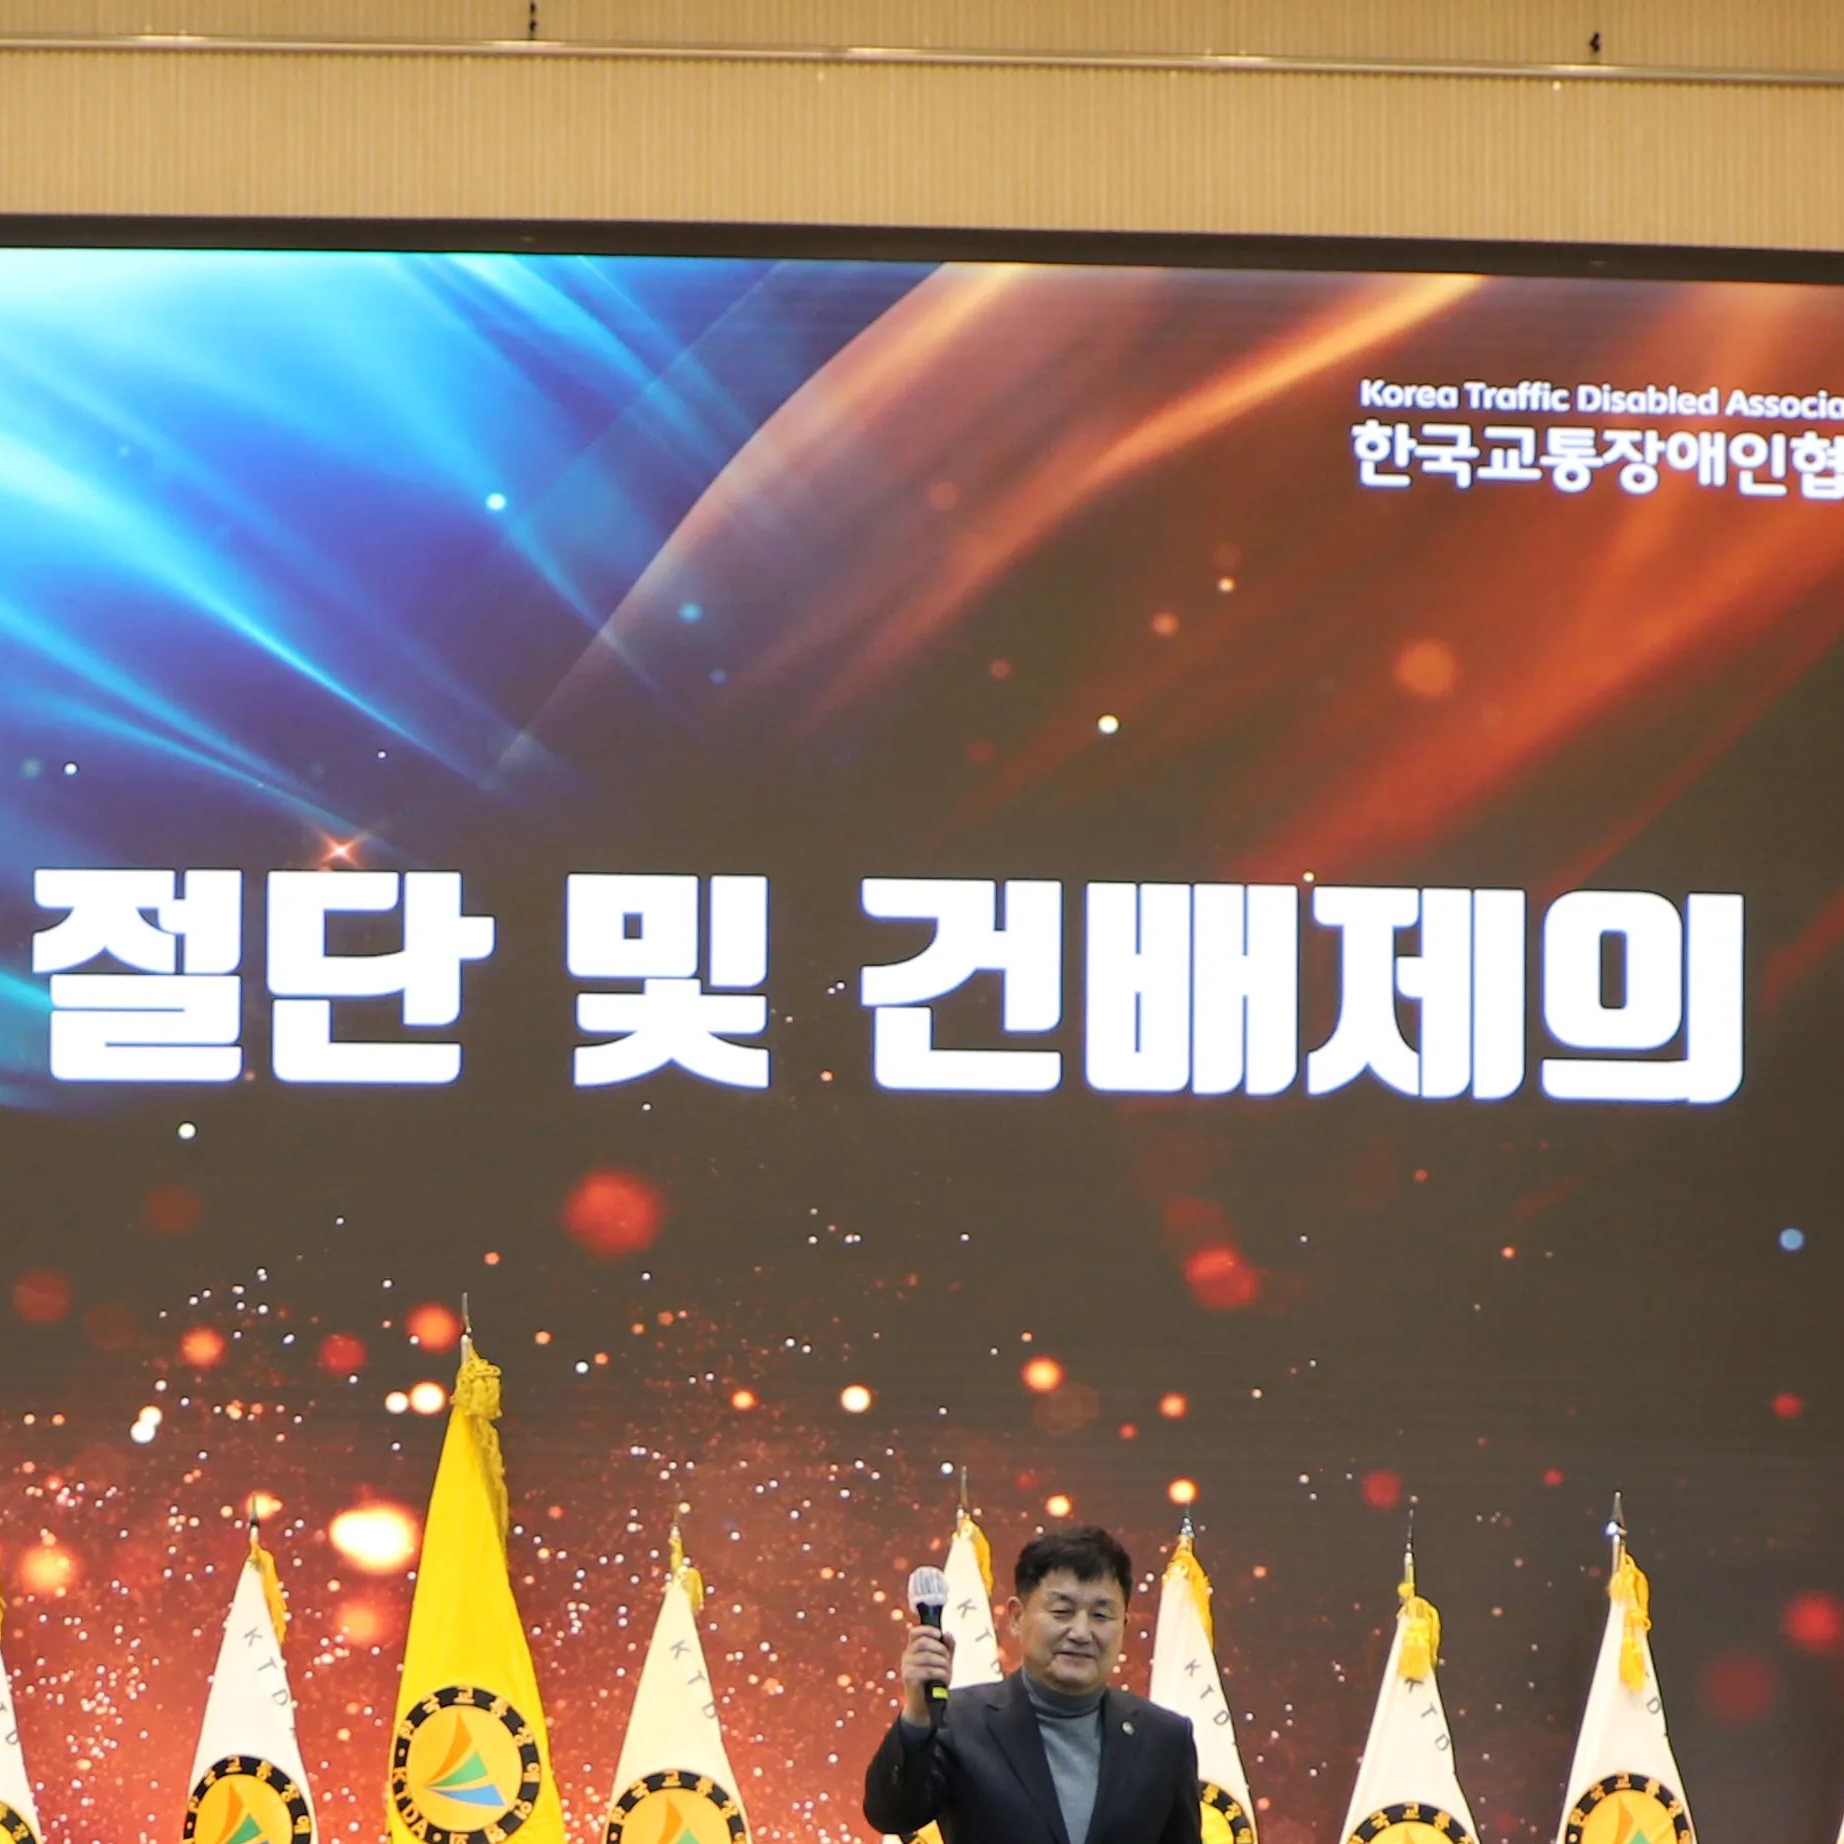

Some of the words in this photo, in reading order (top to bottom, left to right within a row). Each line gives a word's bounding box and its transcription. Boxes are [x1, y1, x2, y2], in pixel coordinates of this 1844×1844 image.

[1359, 379, 1460, 410] Korea
[1464, 380, 1569, 413] Traffic
[1577, 383, 1719, 418] Disabled
[31, 867, 496, 1085] 절단
[566, 872, 770, 1089] 및
[859, 874, 1746, 1105] 건배제의
[391, 1766, 429, 1841] KTDA
